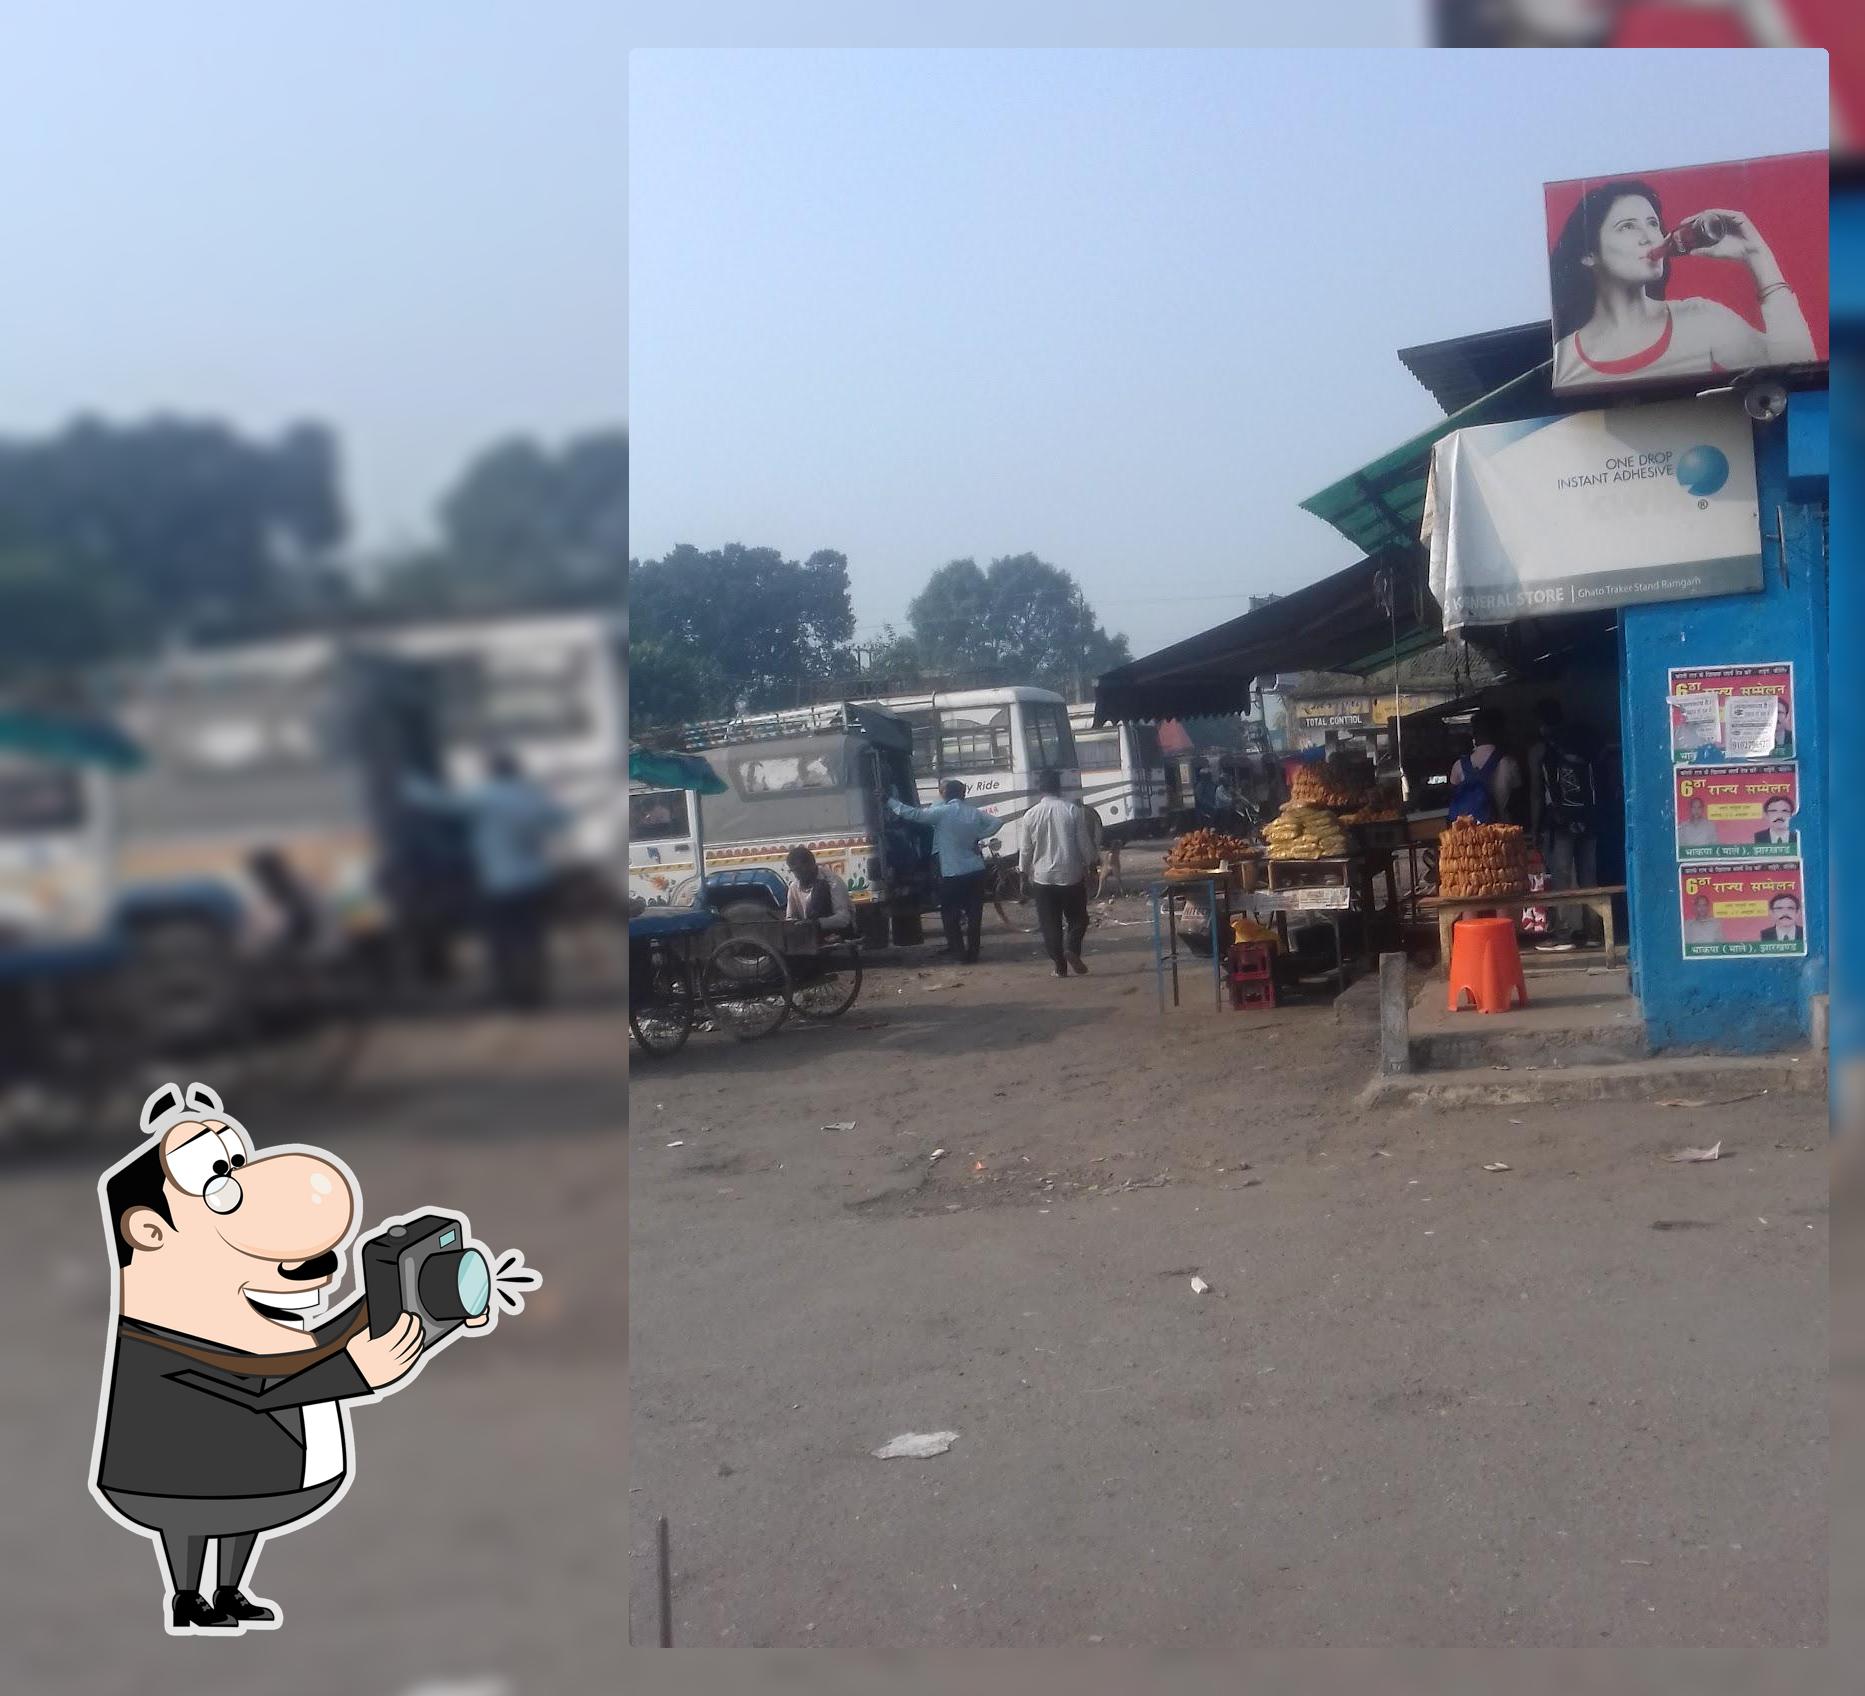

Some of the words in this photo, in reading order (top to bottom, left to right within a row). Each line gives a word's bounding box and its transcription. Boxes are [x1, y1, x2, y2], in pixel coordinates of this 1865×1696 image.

[1605, 456, 1634, 470] ONE
[1638, 451, 1673, 465] DROP
[1557, 473, 1608, 489] INSTANT
[1613, 464, 1674, 483] ADHESIVE
[1517, 587, 1564, 607] STORE
[1634, 581, 1660, 592] Stand
[1306, 717, 1328, 727] TOTAL
[1329, 715, 1363, 726] CONTROL
[976, 780, 1000, 791] Ride
[1707, 784, 1739, 796] राज्य
[1745, 780, 1791, 795] सम्मेलन
[1712, 882, 1744, 893] राज्य
[1750, 878, 1796, 892] सम्मेलन
